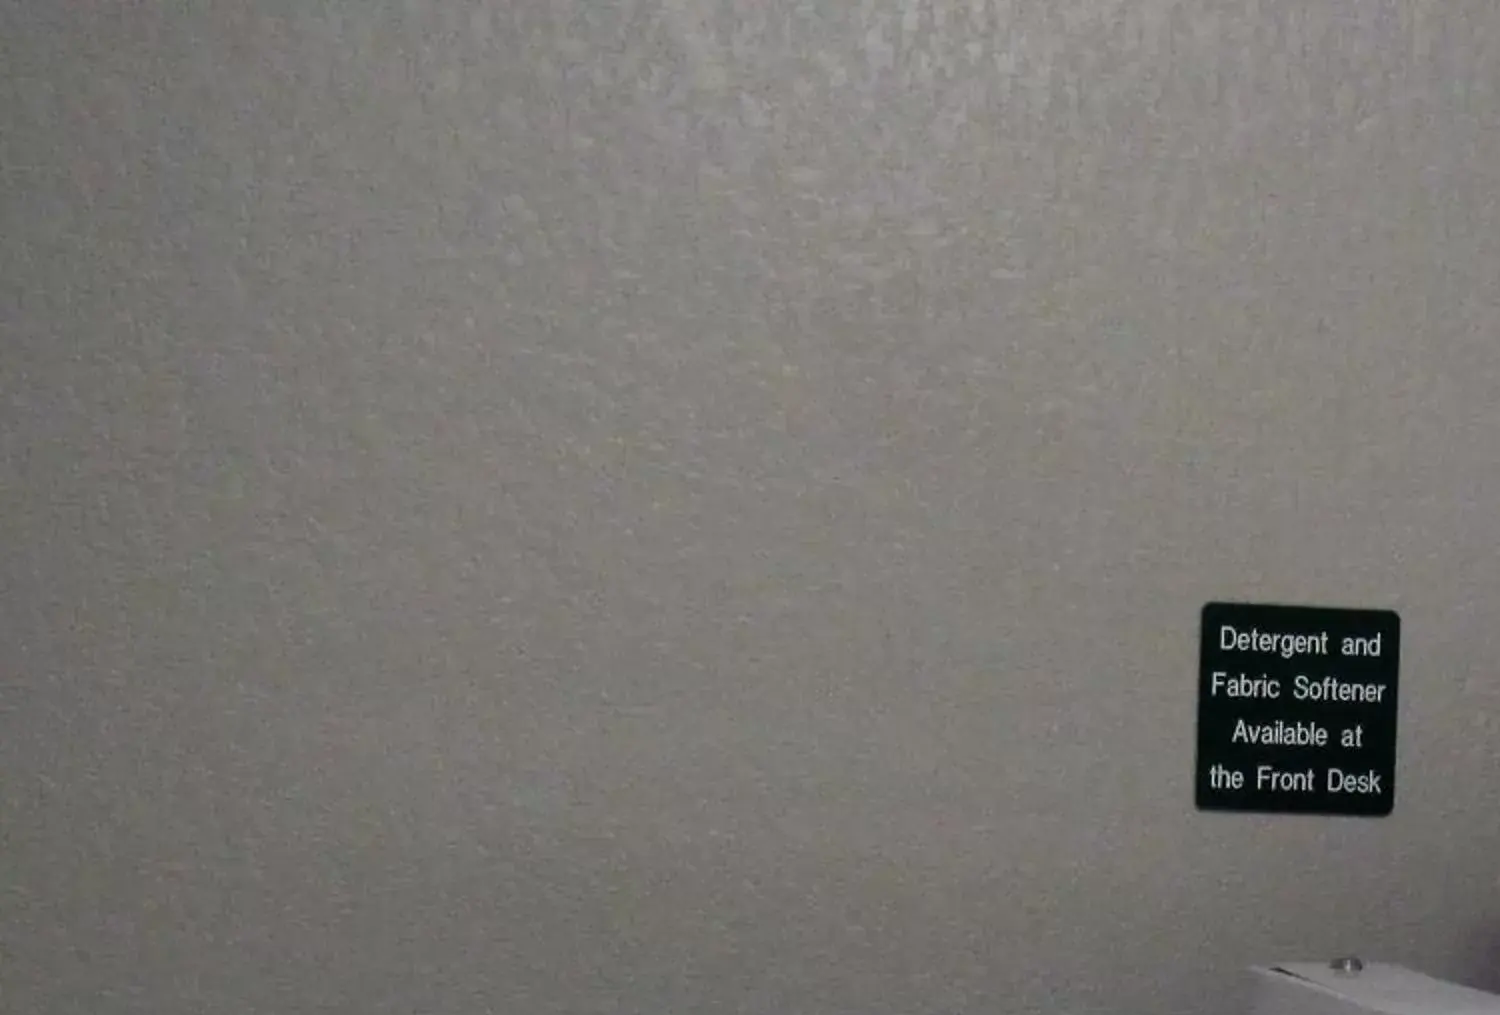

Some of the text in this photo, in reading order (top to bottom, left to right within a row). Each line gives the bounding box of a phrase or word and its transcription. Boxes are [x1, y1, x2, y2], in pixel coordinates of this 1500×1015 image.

[1220, 625, 1382, 658] Detergent and
[1211, 671, 1386, 702] Fabric Softener
[1231, 719, 1363, 747] Available at
[1210, 764, 1382, 793] the Front Desk
